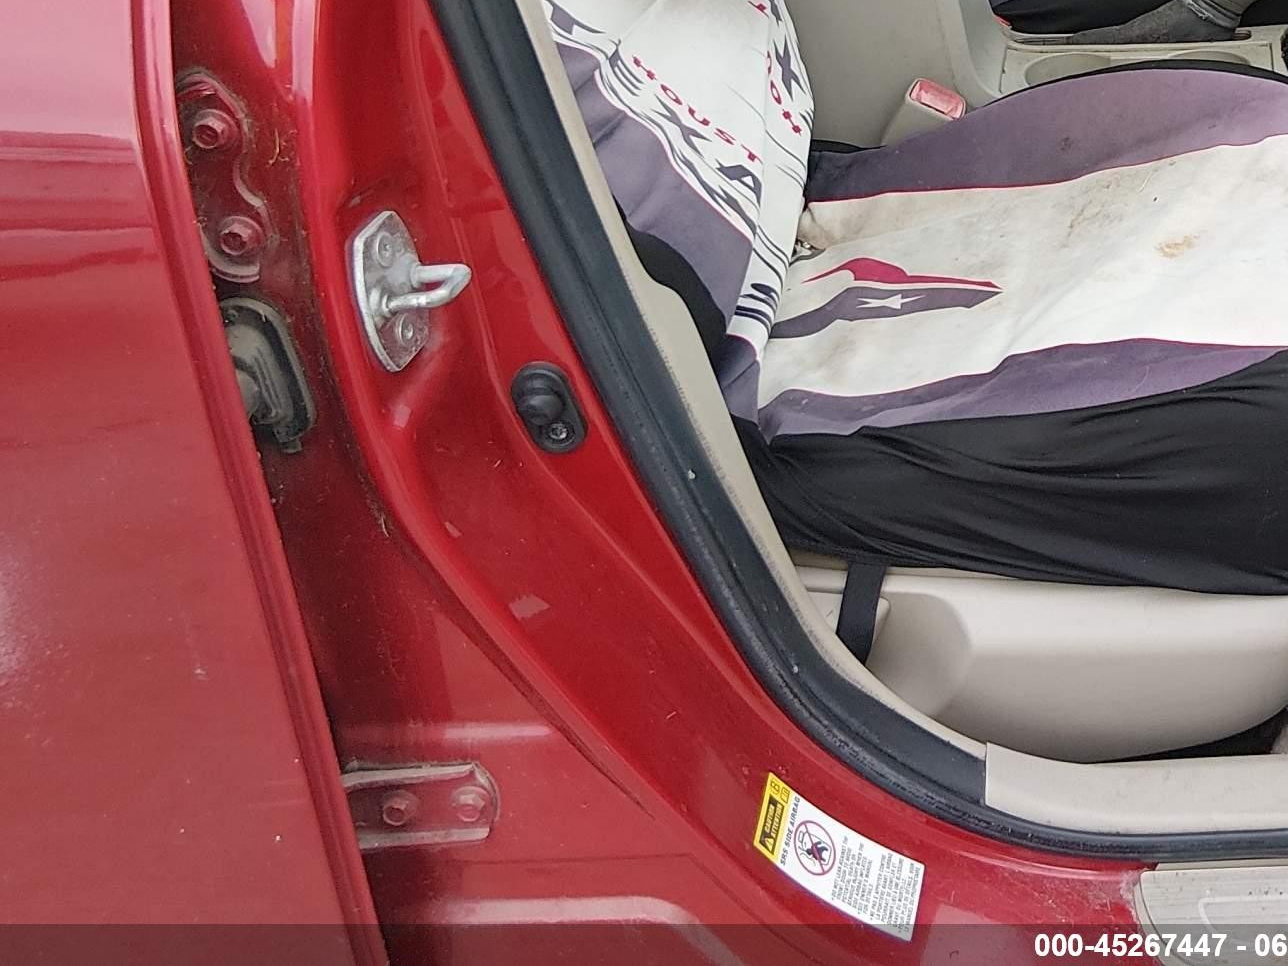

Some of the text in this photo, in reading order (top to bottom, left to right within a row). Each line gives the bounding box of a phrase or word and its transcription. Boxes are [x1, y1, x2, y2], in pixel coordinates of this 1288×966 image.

[780, 796, 800, 866] SRS SIDE AIRBAG
